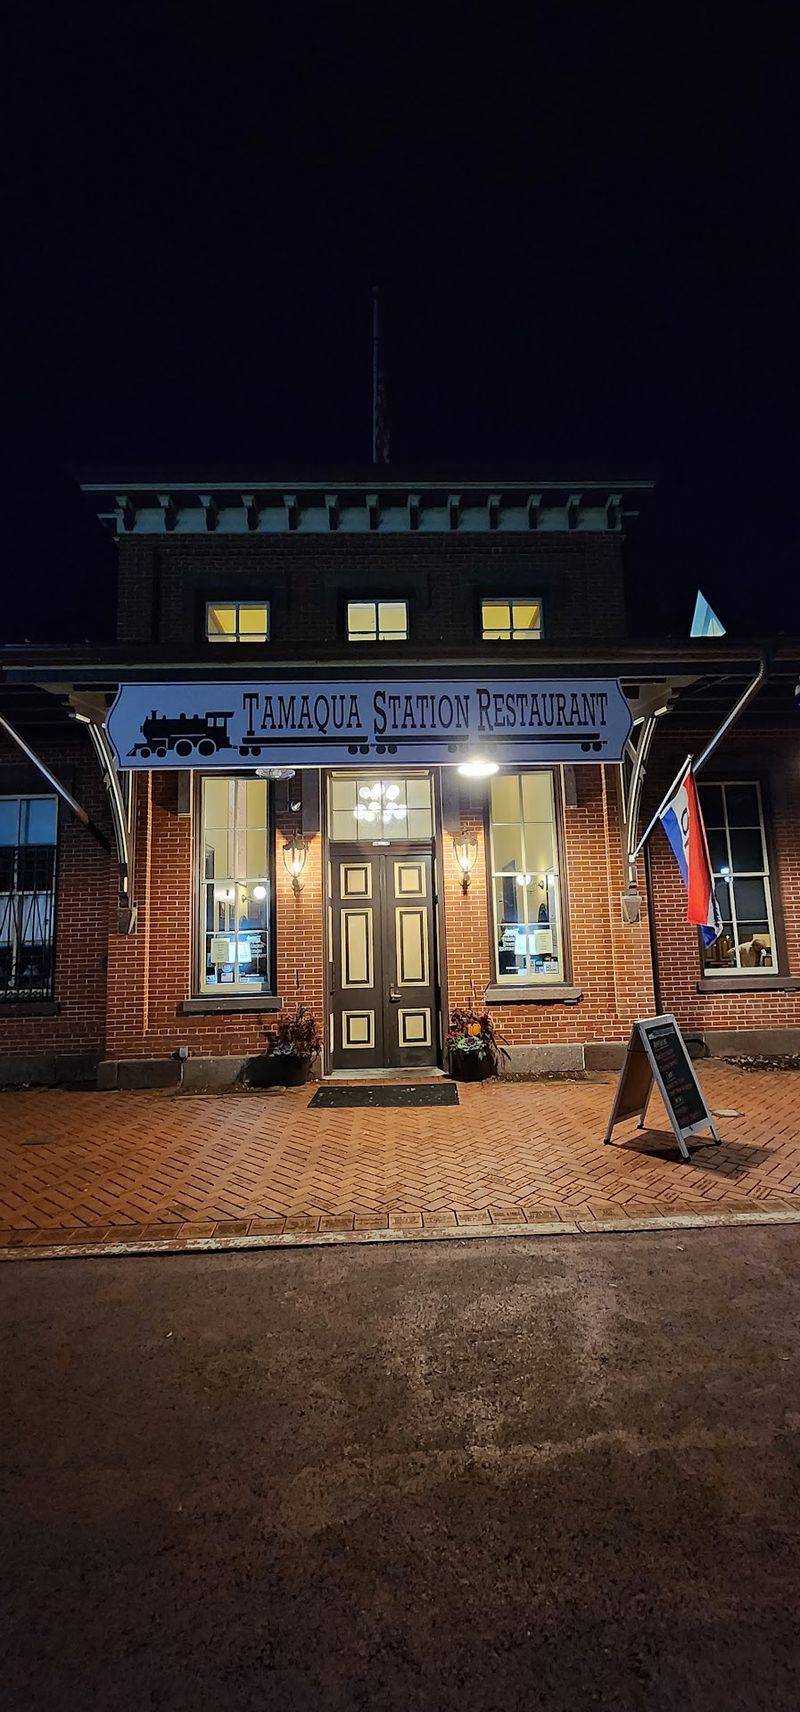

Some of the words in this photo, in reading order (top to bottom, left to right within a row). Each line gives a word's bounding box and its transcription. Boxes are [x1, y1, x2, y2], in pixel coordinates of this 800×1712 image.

[243, 693, 362, 736] TAMAQUA
[374, 691, 470, 734] STATION
[477, 688, 608, 731] RESTAURANT
